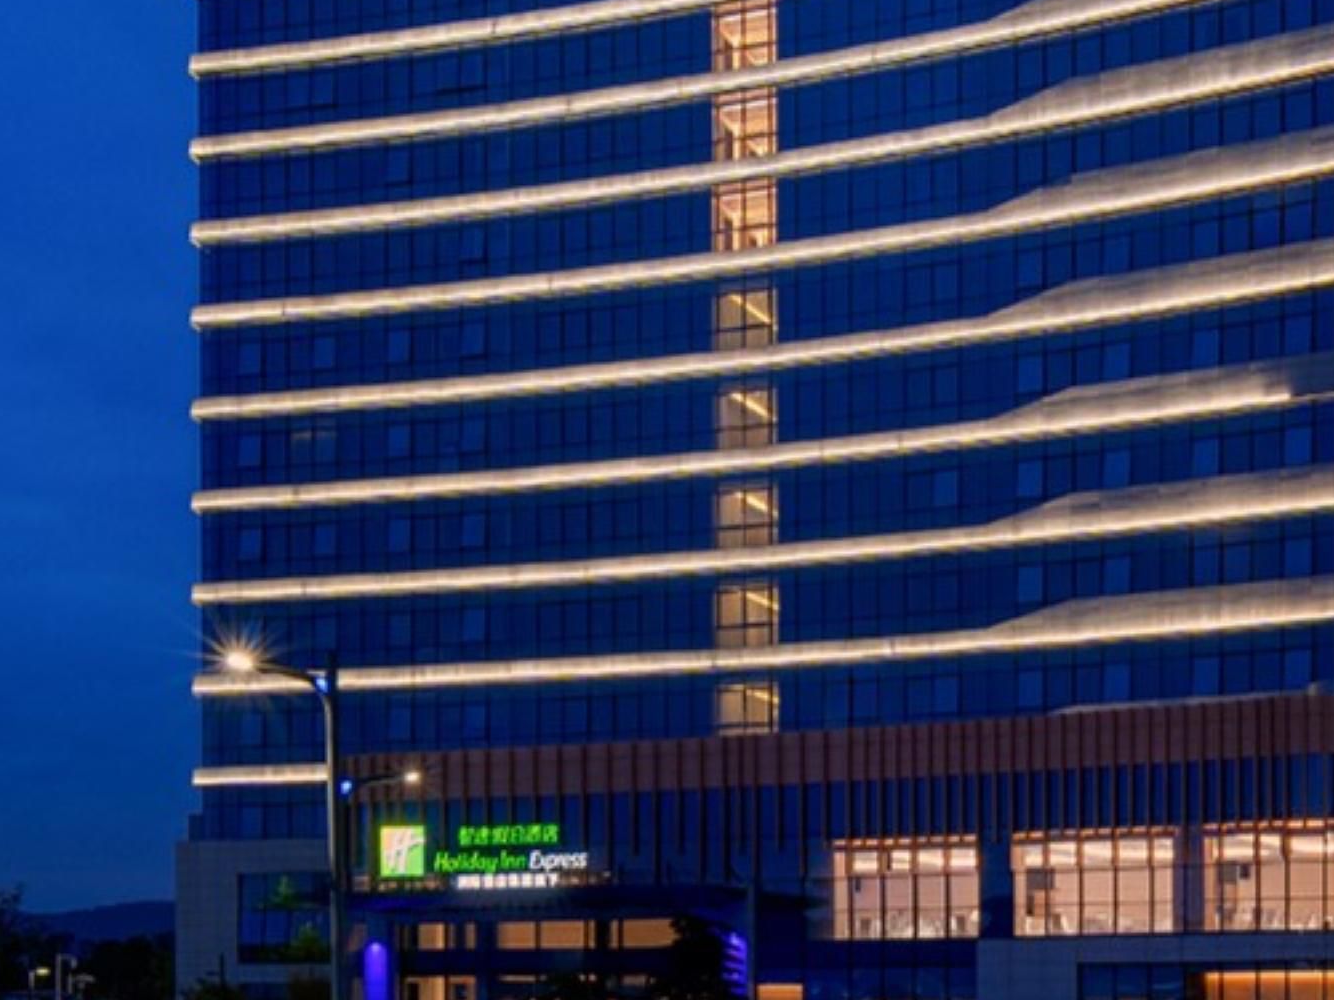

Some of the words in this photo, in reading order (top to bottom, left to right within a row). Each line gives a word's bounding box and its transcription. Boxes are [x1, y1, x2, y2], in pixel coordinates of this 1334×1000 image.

[434, 851, 498, 874] Holiday
[499, 851, 526, 870] Inn
[529, 850, 588, 872] Express
